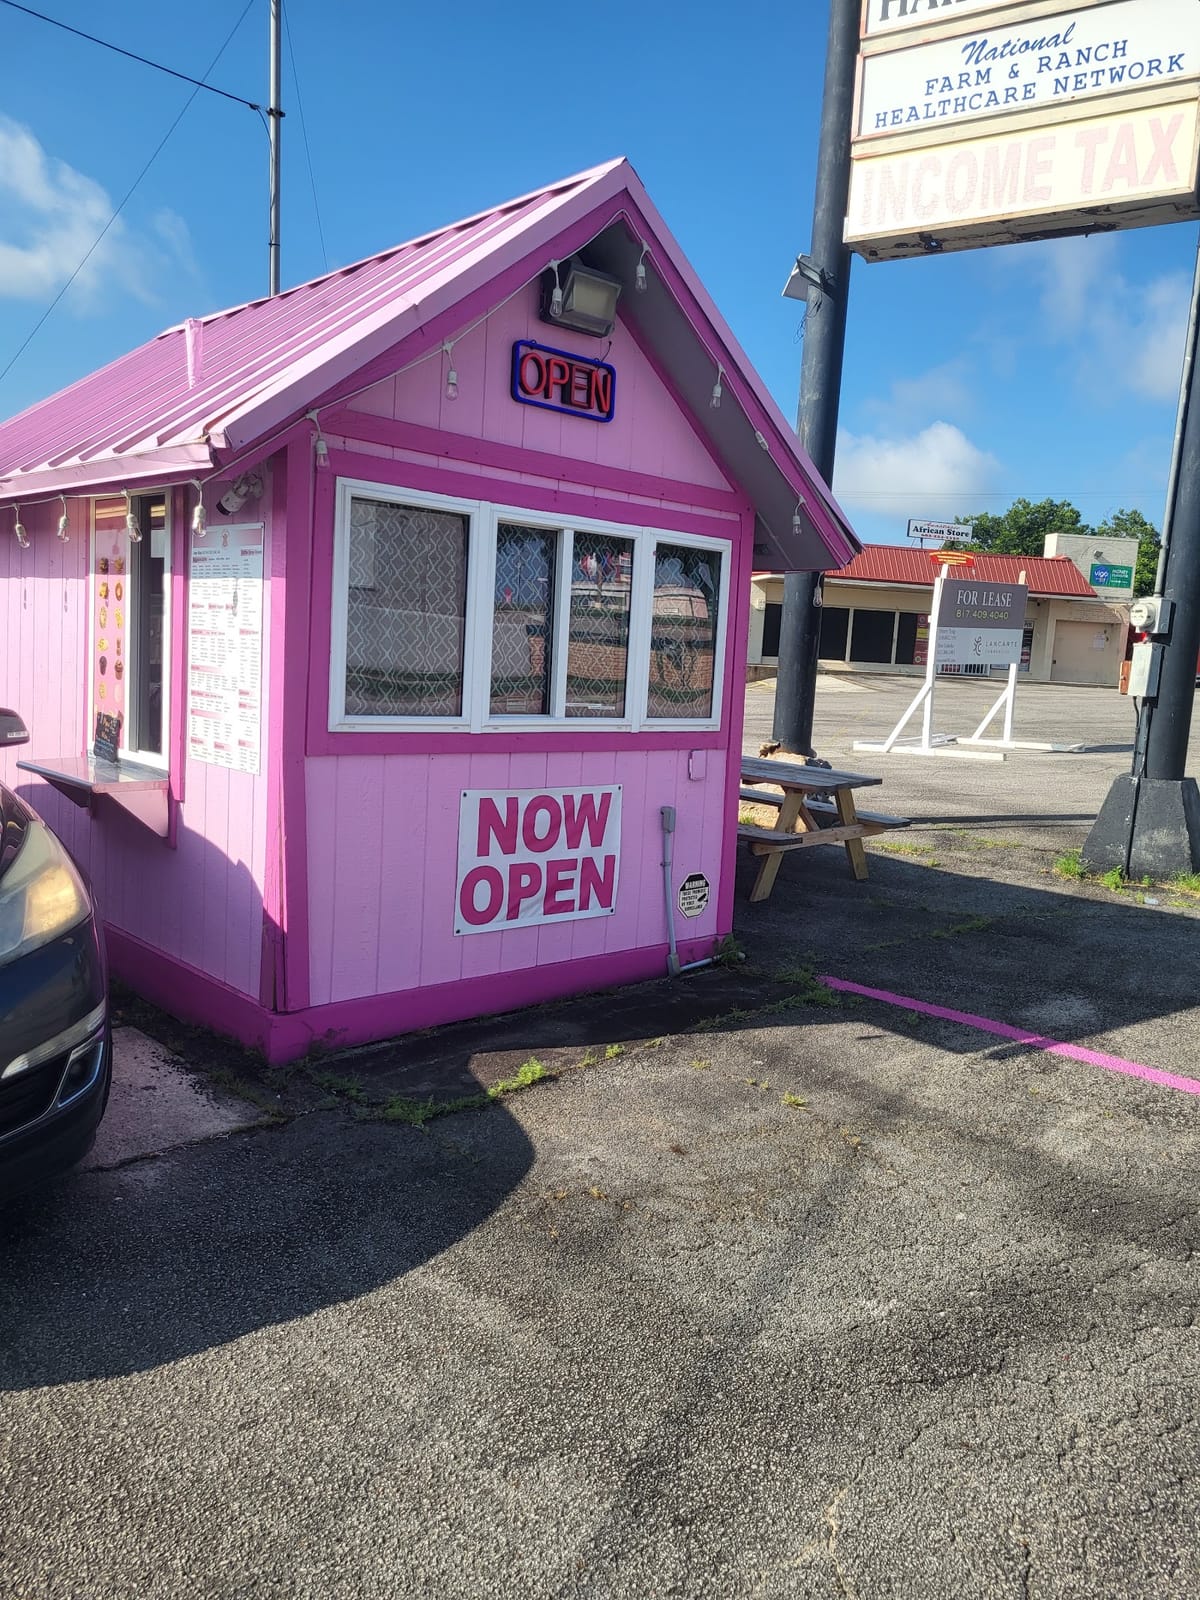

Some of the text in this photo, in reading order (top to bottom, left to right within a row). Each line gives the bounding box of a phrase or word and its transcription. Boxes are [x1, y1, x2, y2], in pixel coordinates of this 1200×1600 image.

[925, 40, 1128, 96] FARM & RANCH
[962, 22, 1076, 65] National
[875, 53, 1186, 129] HEALTHCARE NETWORK
[861, 113, 1186, 227] INCOME TAX
[520, 351, 612, 413] OPEN
[912, 526, 945, 535] African
[946, 529, 970, 538] Store
[957, 590, 1012, 607] FOR LEASE
[477, 792, 612, 857] NOW
[459, 854, 616, 926] OPEN
[685, 879, 706, 890] WARNING
